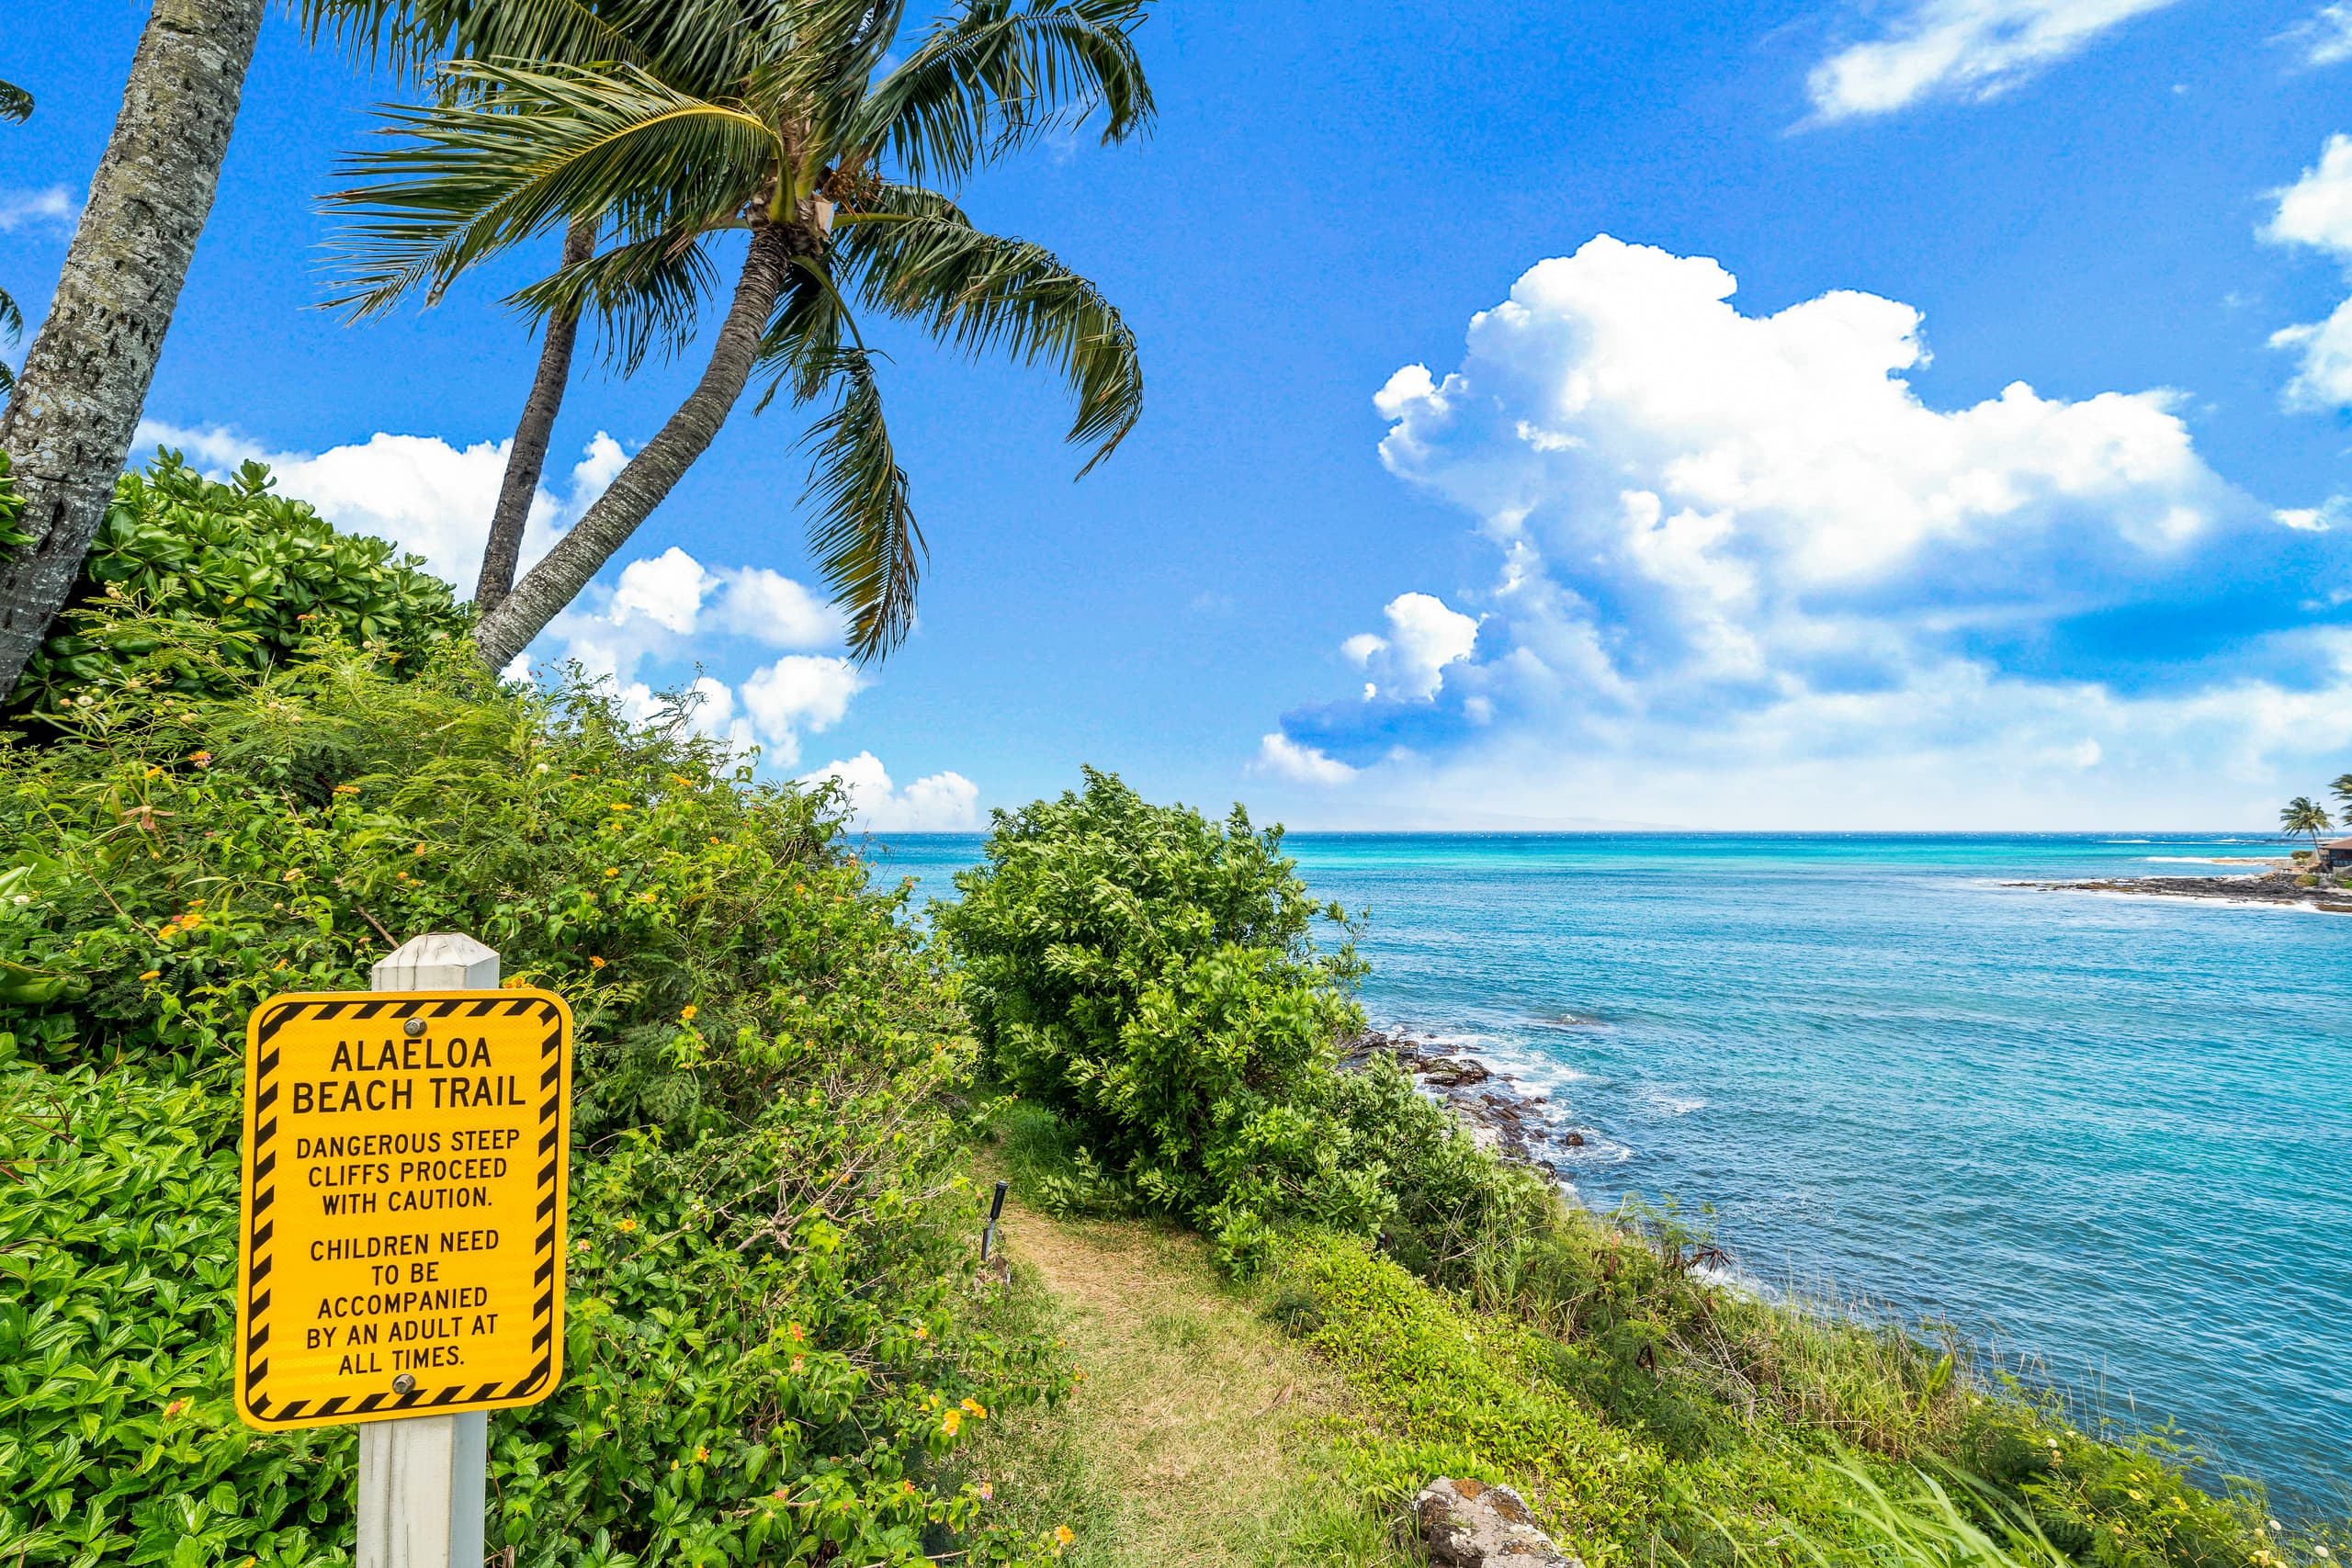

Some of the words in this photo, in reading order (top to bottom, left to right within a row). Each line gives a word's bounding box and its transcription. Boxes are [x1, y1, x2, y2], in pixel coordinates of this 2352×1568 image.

[330, 1037, 492, 1073] ALAELOA
[292, 1078, 413, 1114] BEACH
[429, 1075, 526, 1109] TRAIL
[296, 1132, 441, 1159] DANGEROUS
[450, 1128, 520, 1152] STEEP
[308, 1163, 390, 1188] CLIFFS
[401, 1157, 507, 1183] PROCEED
[322, 1192, 377, 1216] WITH
[388, 1186, 492, 1212] CAUTION.
[311, 1234, 429, 1262] CHILDREN
[440, 1229, 499, 1253] NEED
[371, 1264, 399, 1286] TO
[411, 1261, 439, 1284] BE
[317, 1286, 488, 1320] ACCOMPANIED
[307, 1326, 337, 1349] BY
[346, 1323, 378, 1347] AN
[388, 1316, 463, 1343] ADULT
[471, 1314, 498, 1336] AT
[338, 1352, 382, 1376] ALL
[391, 1345, 465, 1371] TIMES.
